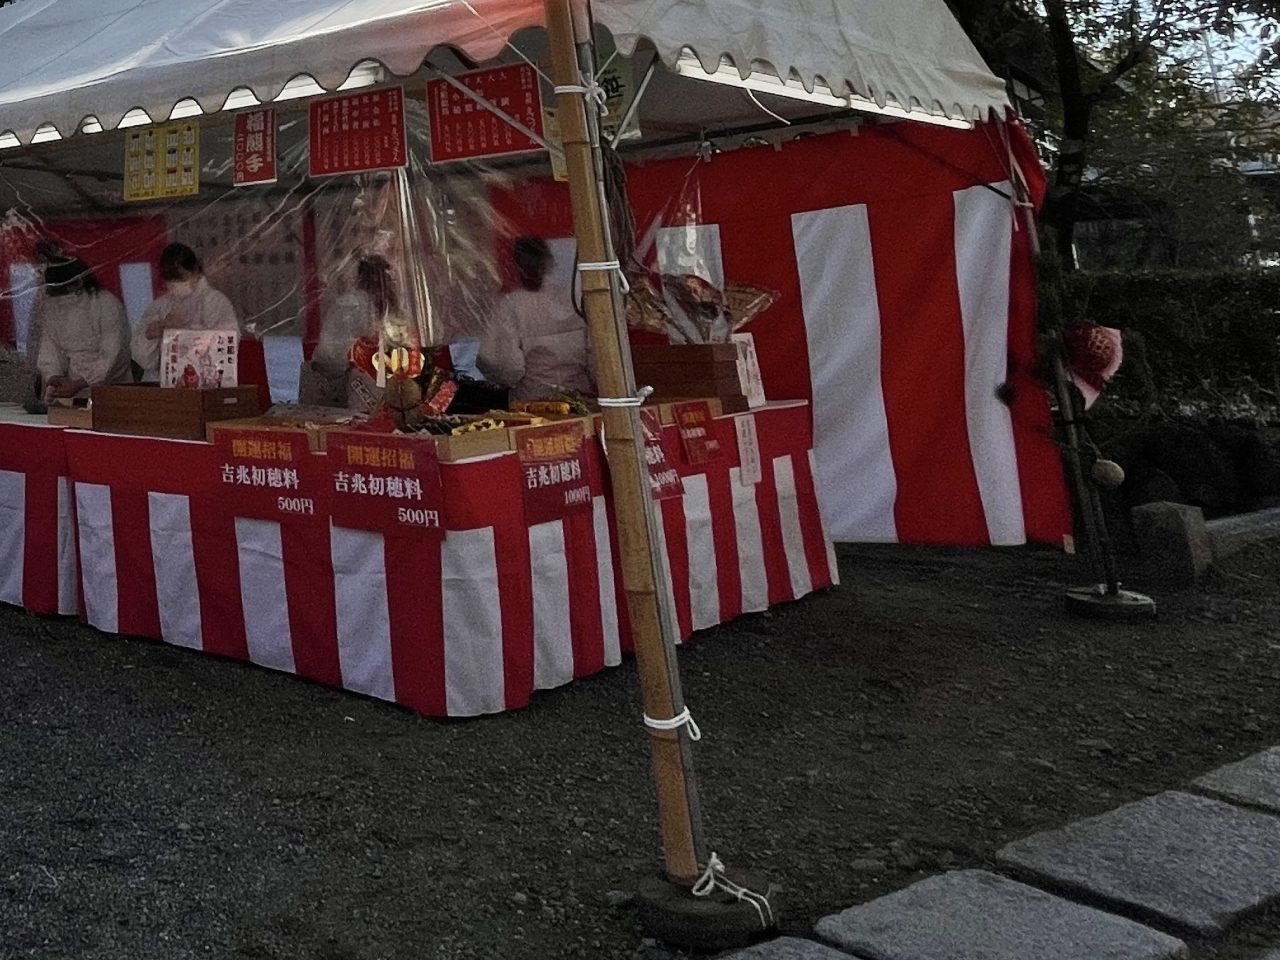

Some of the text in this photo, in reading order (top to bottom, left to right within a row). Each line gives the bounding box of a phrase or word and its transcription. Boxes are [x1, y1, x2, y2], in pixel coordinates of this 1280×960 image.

[232, 440, 293, 461] 開運招福
[347, 445, 416, 470] 開運招福
[220, 463, 299, 490] 吉兆初穂料
[333, 471, 424, 501] 吉兆初穂料
[526, 458, 581, 489] 吉兆初穂料
[277, 496, 314, 514] 500円
[397, 507, 440, 527] 500円
